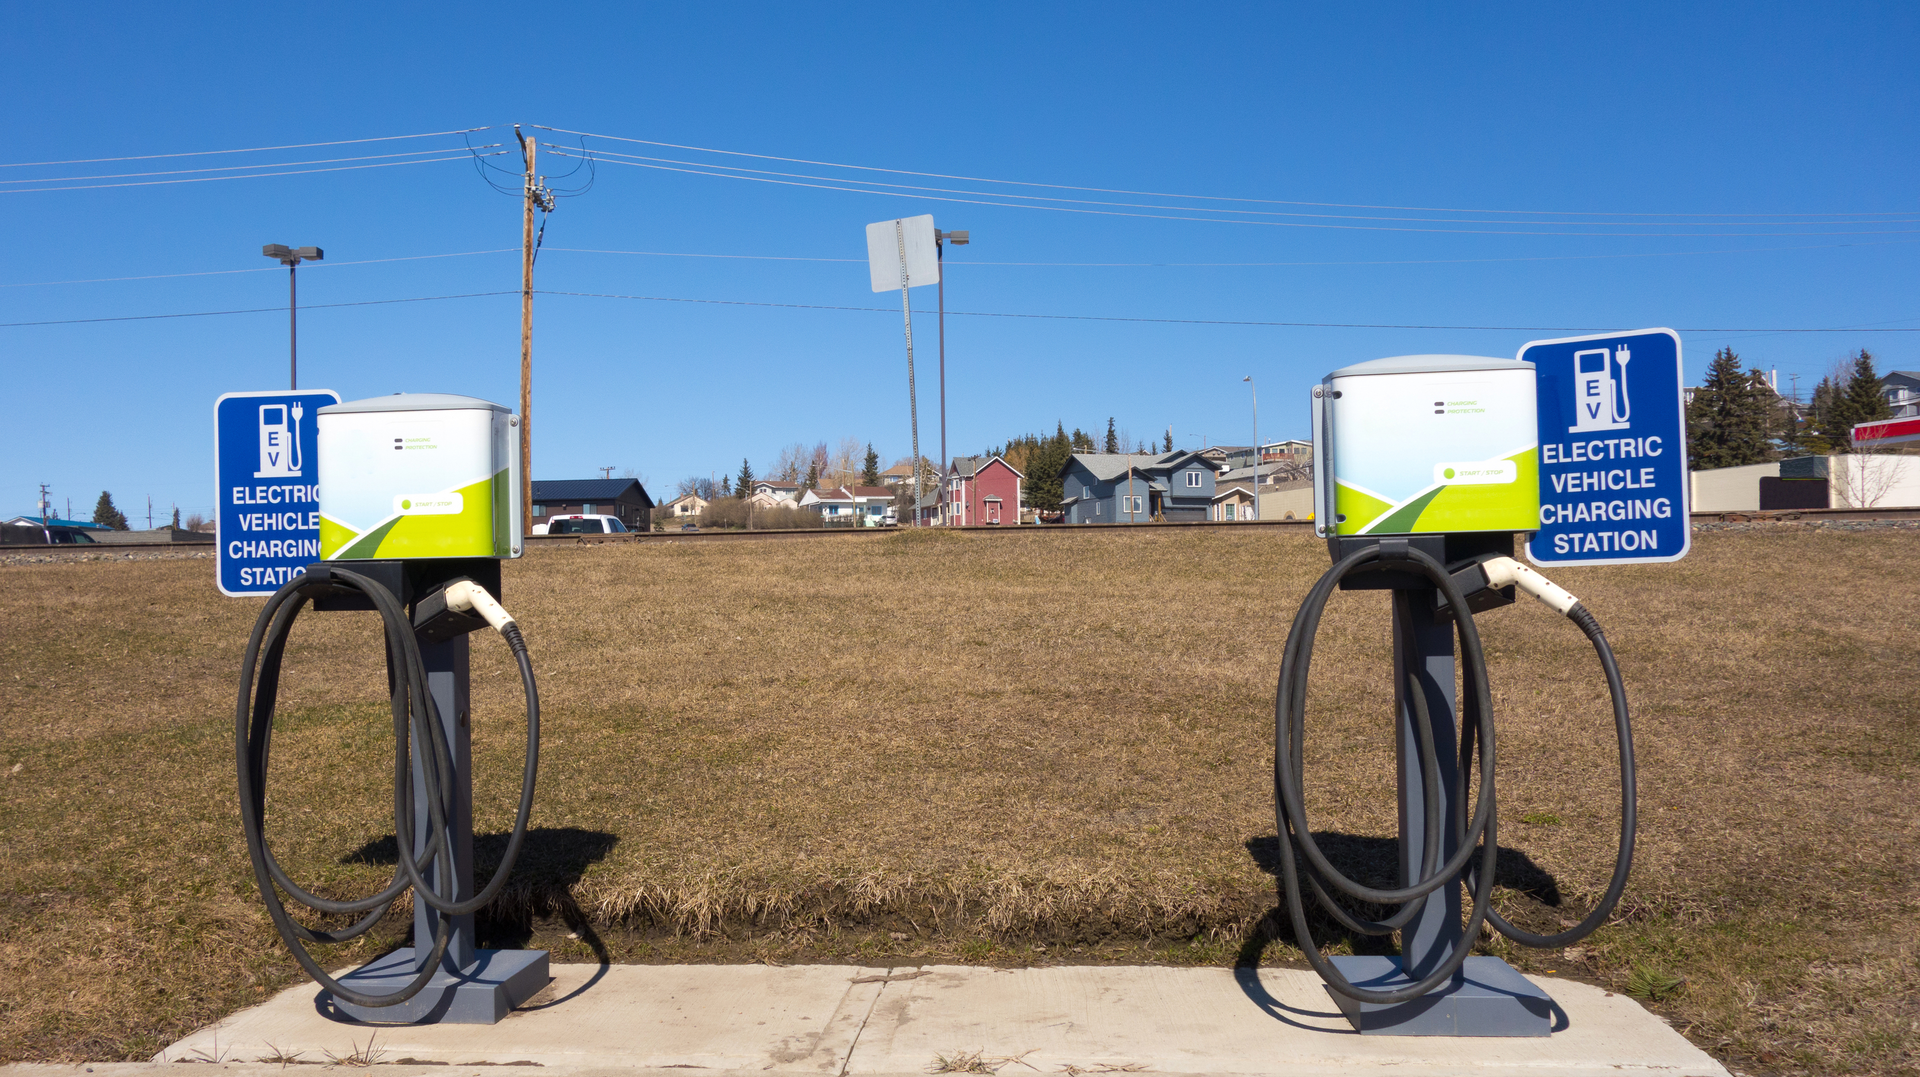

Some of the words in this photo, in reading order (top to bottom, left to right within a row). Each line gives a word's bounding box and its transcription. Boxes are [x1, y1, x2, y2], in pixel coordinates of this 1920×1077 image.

[1543, 436, 1662, 464] ELECTRIC
[1551, 468, 1656, 493] VEHICLE
[238, 512, 320, 531] VEHICLE
[1540, 498, 1671, 524] CHARGING
[228, 539, 322, 559] CHARGIN
[1554, 530, 1658, 554] STATION
